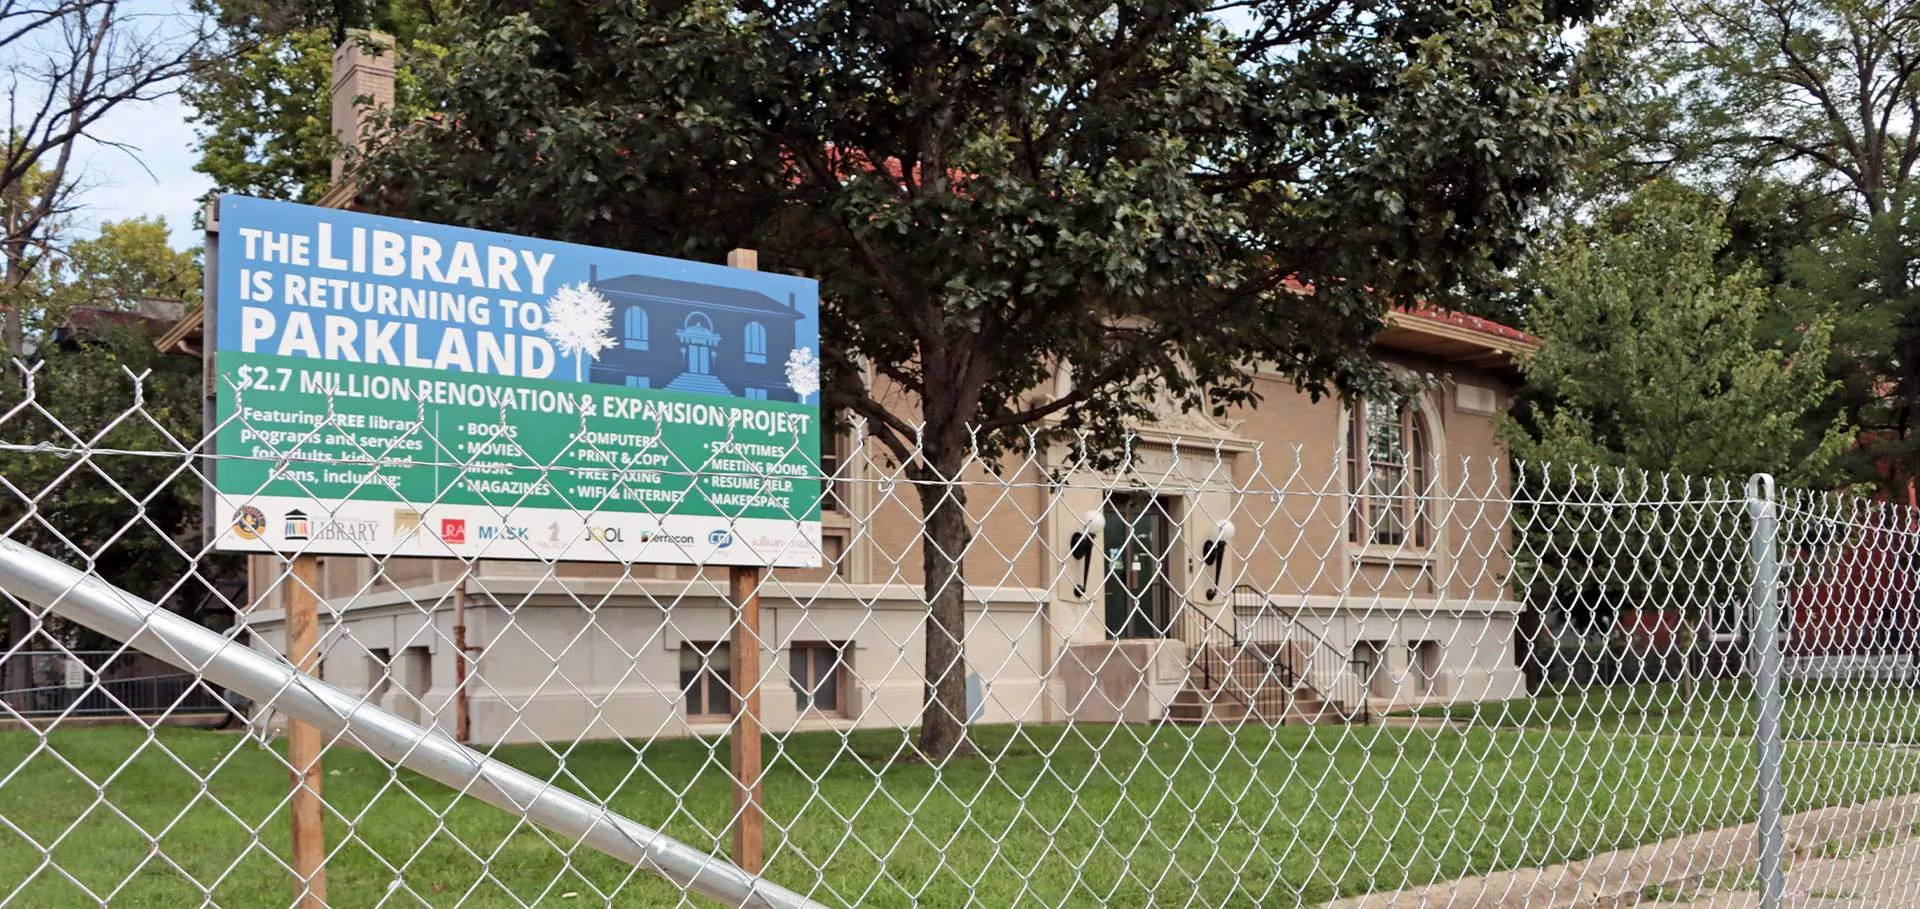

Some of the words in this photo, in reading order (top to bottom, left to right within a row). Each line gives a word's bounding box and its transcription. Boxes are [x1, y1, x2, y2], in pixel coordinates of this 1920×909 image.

[240, 228, 310, 266] THE
[318, 222, 556, 295] LIBRARY
[240, 269, 273, 302] IS
[285, 274, 489, 326] RETURNING
[499, 299, 544, 331] TO
[241, 306, 556, 380] PARKLAND
[238, 364, 293, 391] $2.7
[301, 370, 409, 401] MILLION
[418, 379, 573, 414] RENOVATION
[581, 394, 597, 417] &
[603, 396, 724, 427] EXPANSION
[729, 408, 810, 437] PROJECT
[244, 407, 324, 428] Featuring
[328, 414, 365, 428] REE
[369, 415, 420, 435] library
[241, 429, 321, 445] programs
[325, 433, 356, 446] and
[360, 436, 423, 450] services
[468, 441, 522, 457] MOVIES
[578, 449, 618, 463] PRINT
[621, 452, 632, 464] &
[634, 453, 669, 466] COPY
[711, 441, 784, 458] STORYTIMES
[578, 467, 609, 480] FREE
[712, 459, 763, 473] MEETING
[766, 462, 808, 476] ROOMS
[467, 479, 550, 496] MAGAZINES
[712, 476, 760, 490] RESUME
[712, 493, 790, 509] MAKERSPACE
[310, 520, 379, 541] LIBRARY
